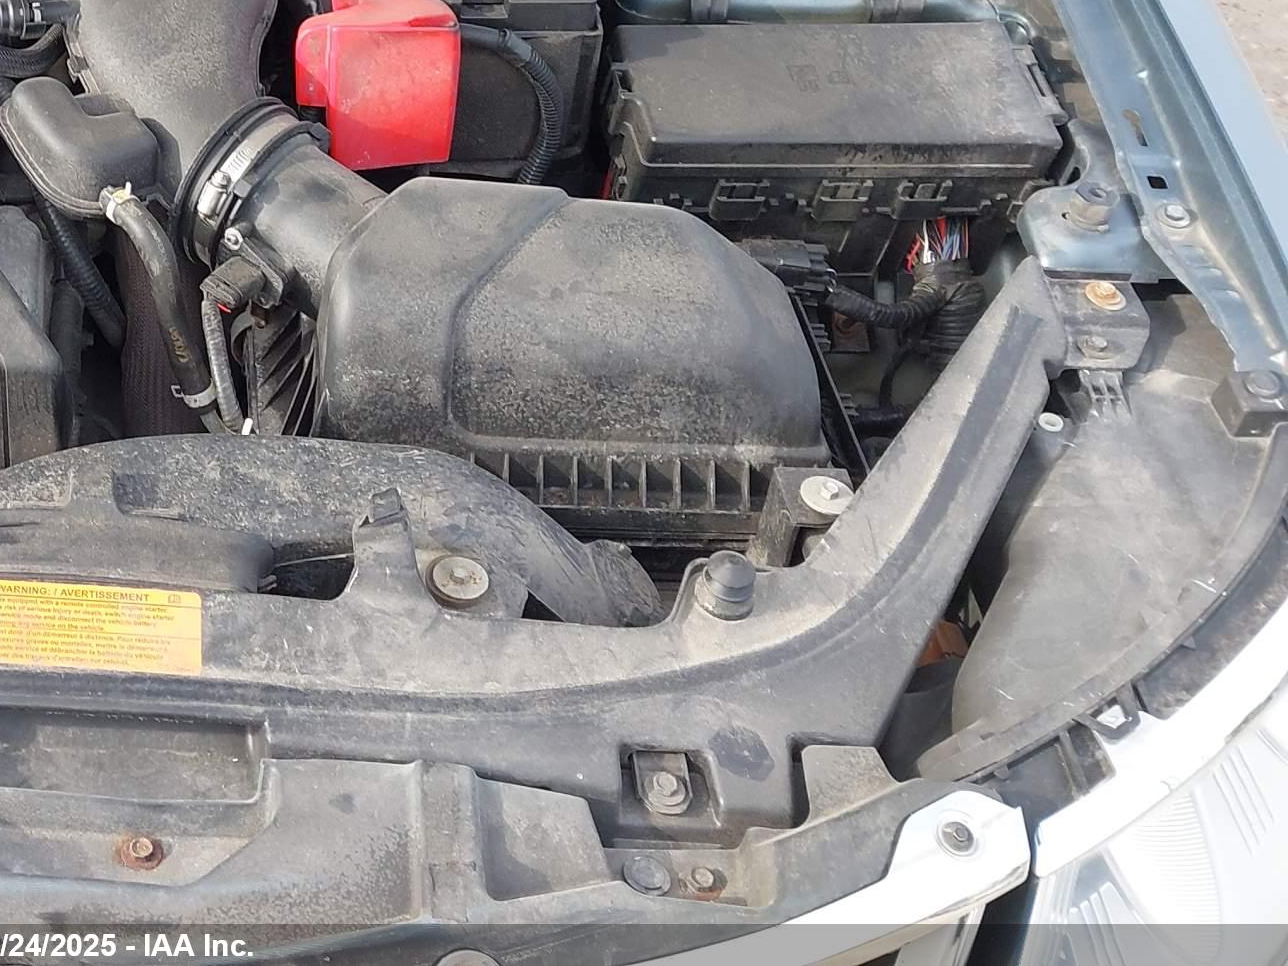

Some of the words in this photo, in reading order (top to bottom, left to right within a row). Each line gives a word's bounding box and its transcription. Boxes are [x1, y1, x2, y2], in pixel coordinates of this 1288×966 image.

[60, 589, 150, 603] AVERTISSEMENT
[85, 603, 119, 611] controlled
[53, 607, 72, 616] injury
[58, 615, 94, 623] disconnect
